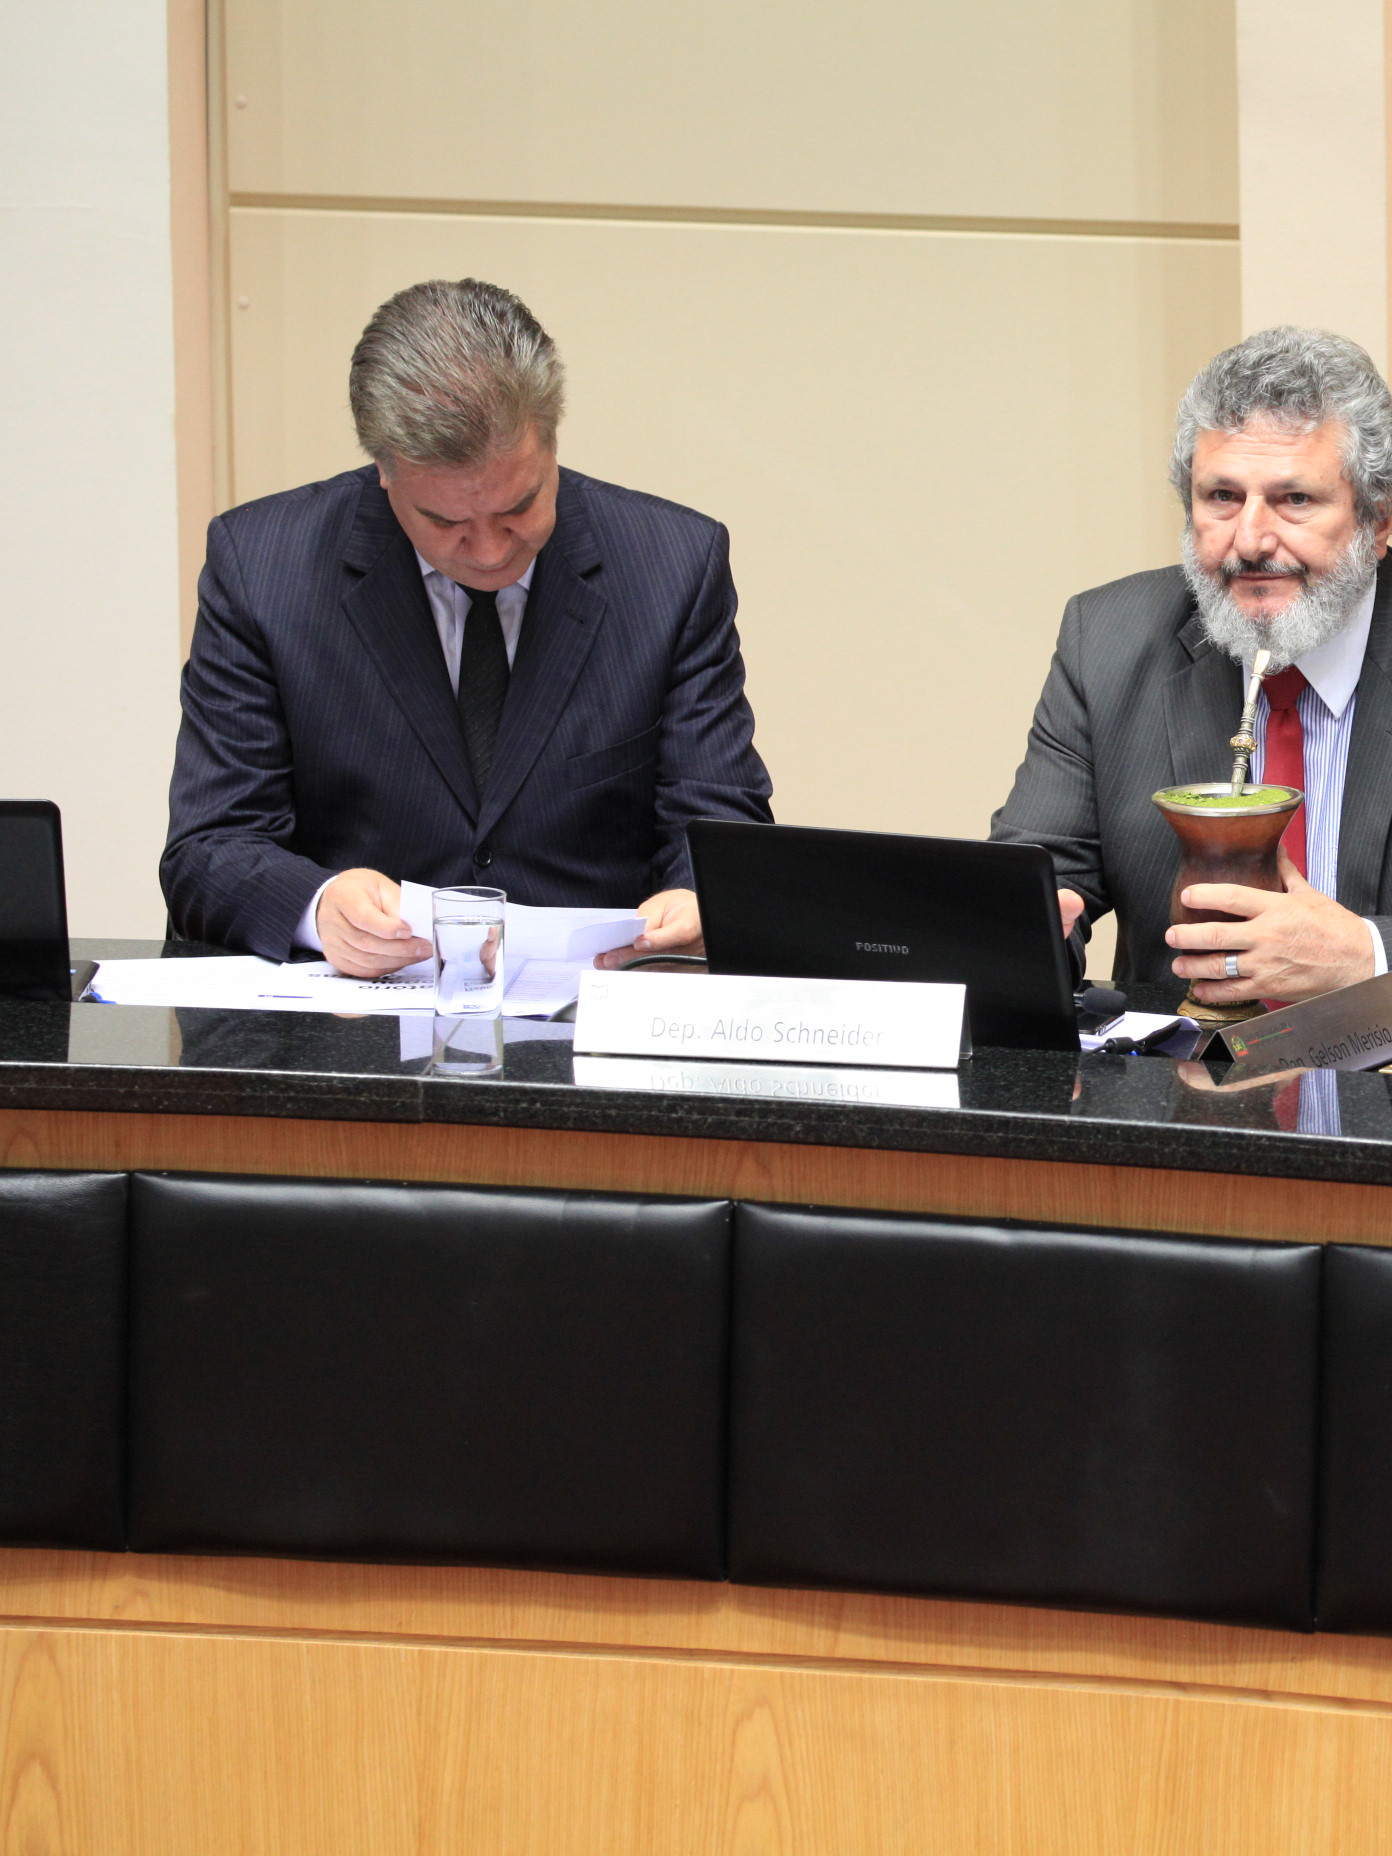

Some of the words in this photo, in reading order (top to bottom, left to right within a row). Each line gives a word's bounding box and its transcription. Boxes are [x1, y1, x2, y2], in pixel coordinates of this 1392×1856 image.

[855, 941, 909, 956] POSITIVO
[651, 1016, 701, 1044] Dep.
[711, 1018, 763, 1043] Aldo
[773, 1020, 885, 1048] Schneider
[1308, 1042, 1351, 1068] Gelson
[1348, 1024, 1392, 1056] Merisio
